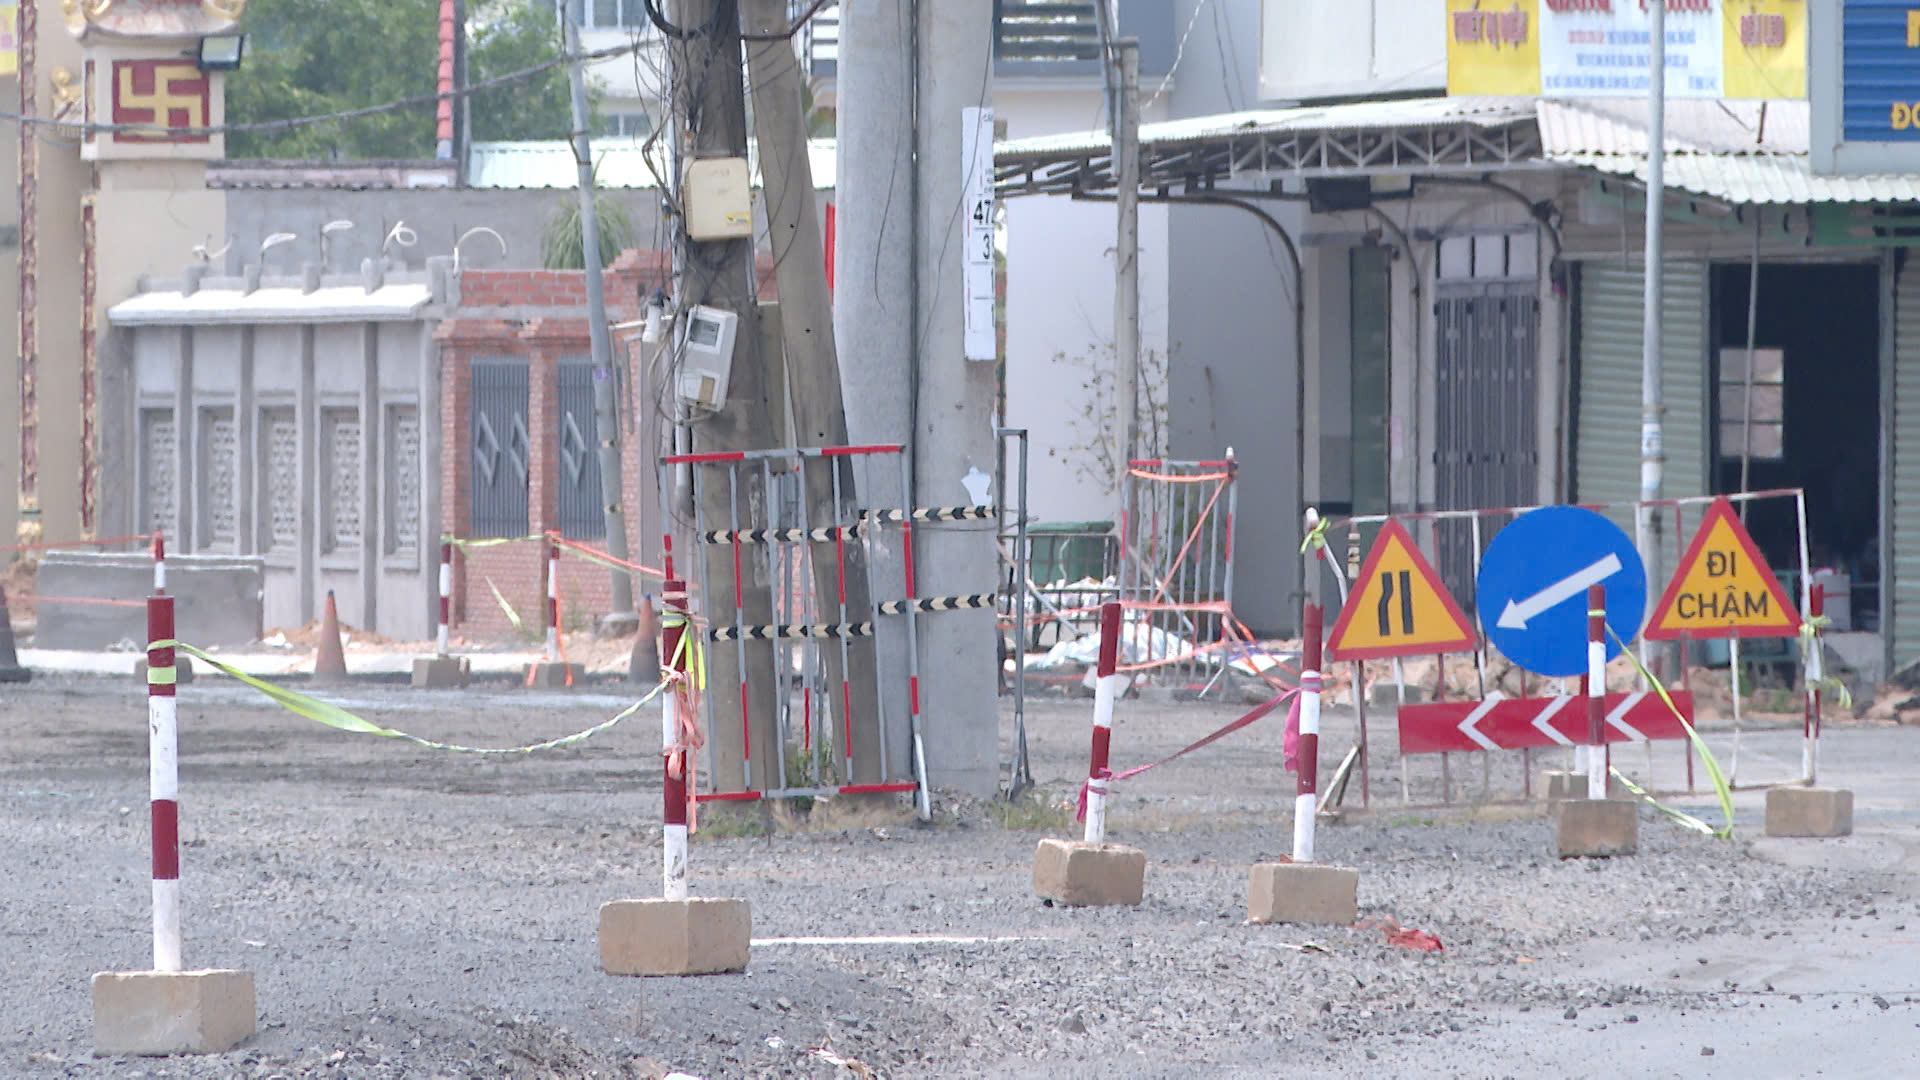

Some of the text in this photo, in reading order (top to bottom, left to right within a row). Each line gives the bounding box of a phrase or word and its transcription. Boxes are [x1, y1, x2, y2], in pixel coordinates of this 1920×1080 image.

[973, 199, 993, 226] 47
[1706, 551, 1736, 577] ĐI
[1677, 585, 1768, 624] CHẬM
